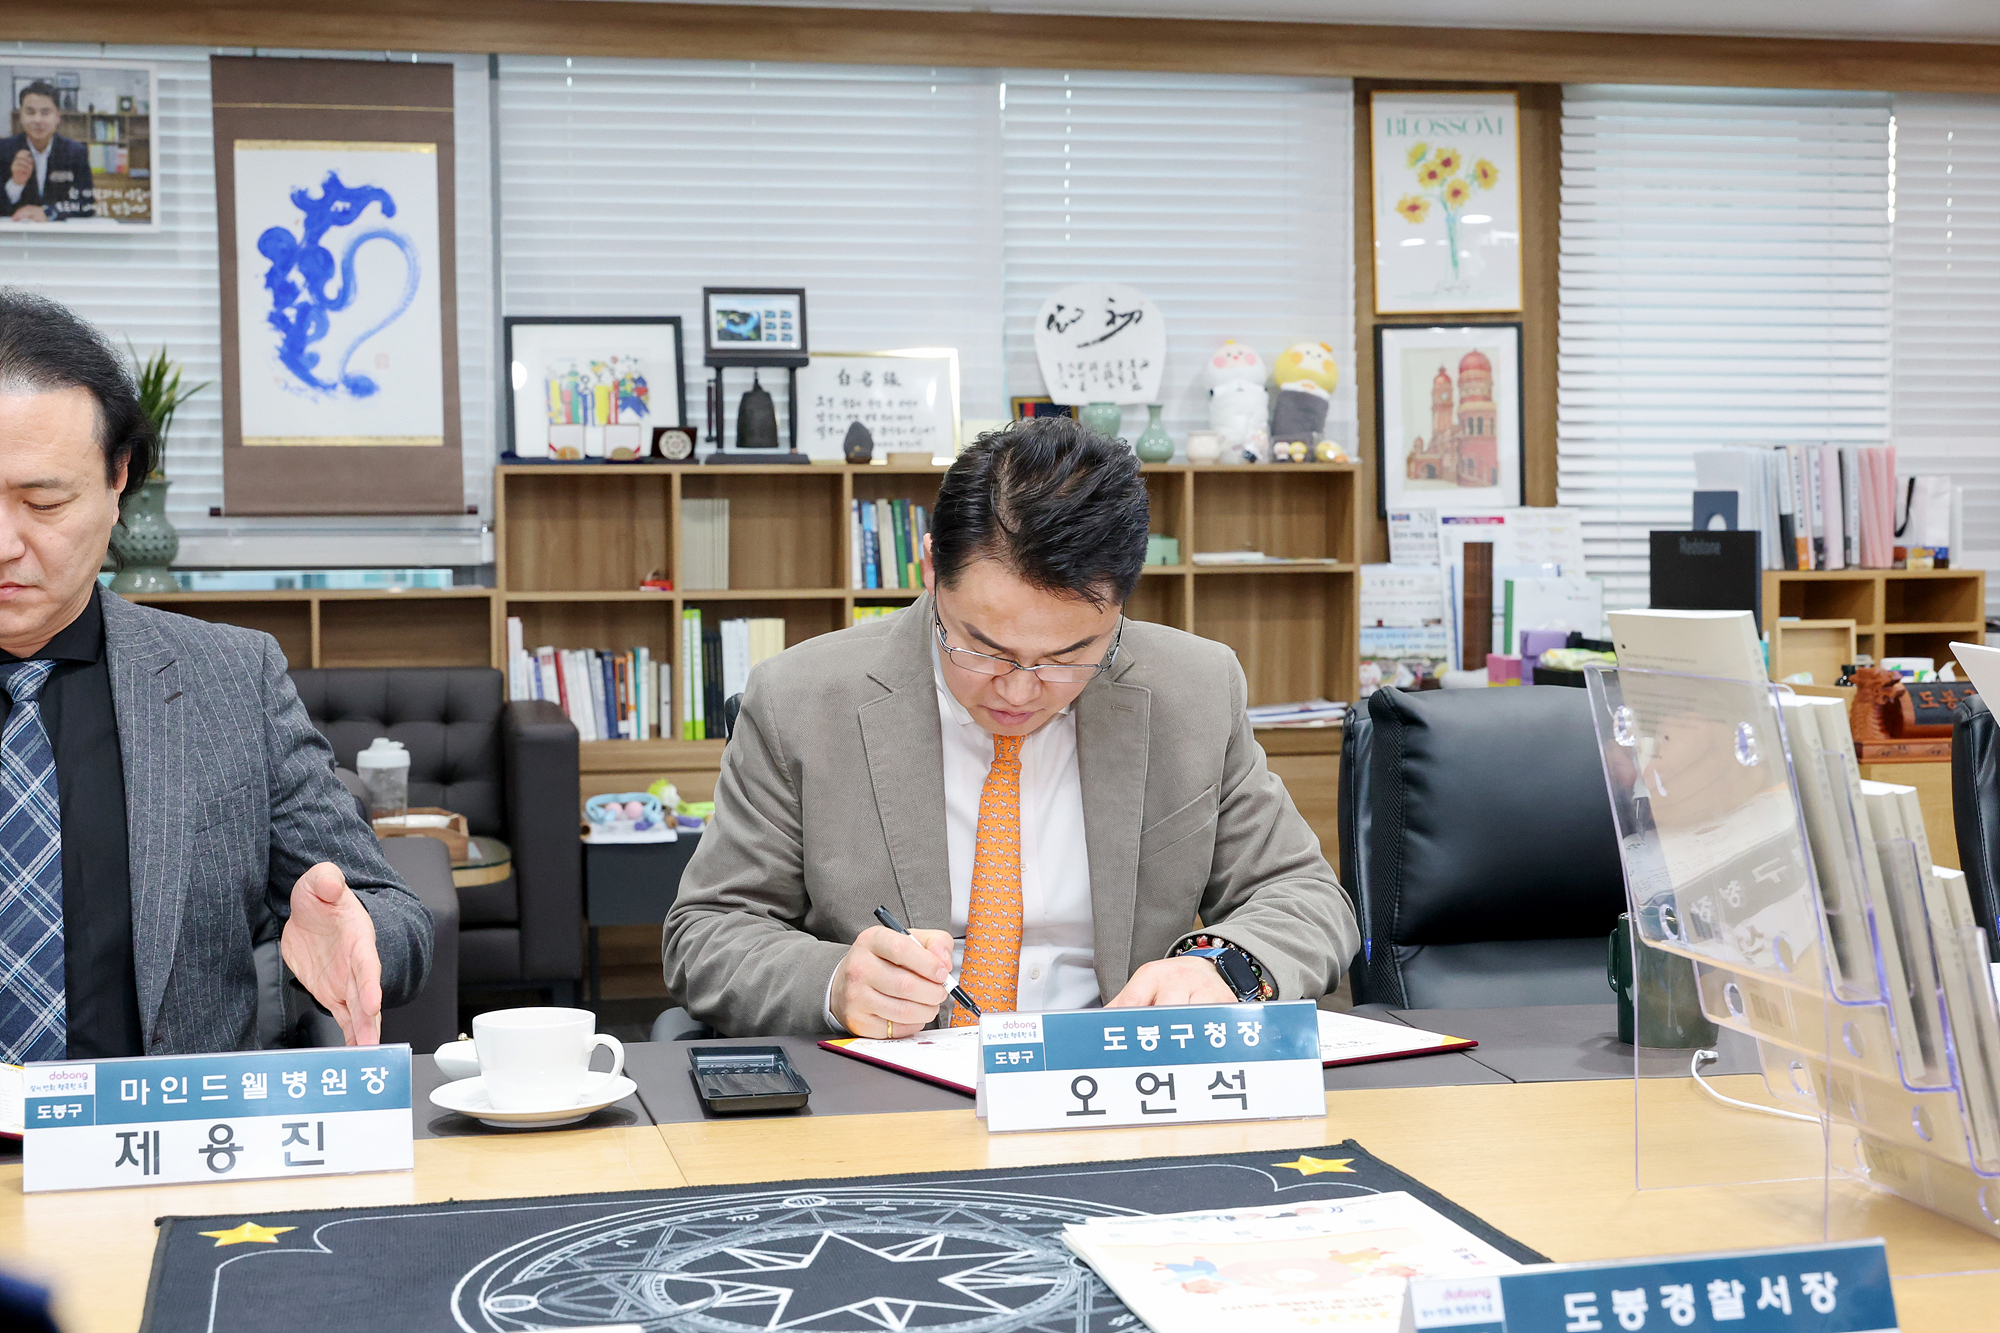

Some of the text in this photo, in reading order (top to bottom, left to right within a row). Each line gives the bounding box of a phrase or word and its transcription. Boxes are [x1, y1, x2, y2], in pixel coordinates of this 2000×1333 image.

[1386, 117, 1503, 137] BLOSSOM
[1003, 1020, 1037, 1030] dobong
[1103, 1021, 1263, 1051] 도봉구청장
[995, 1050, 1034, 1065] 도봉구
[49, 1070, 89, 1081] dobong
[120, 1066, 390, 1106] 마인드웰병원장
[37, 1103, 83, 1120] 도봉구
[1563, 1271, 1839, 1333] 도봉경찰서장
